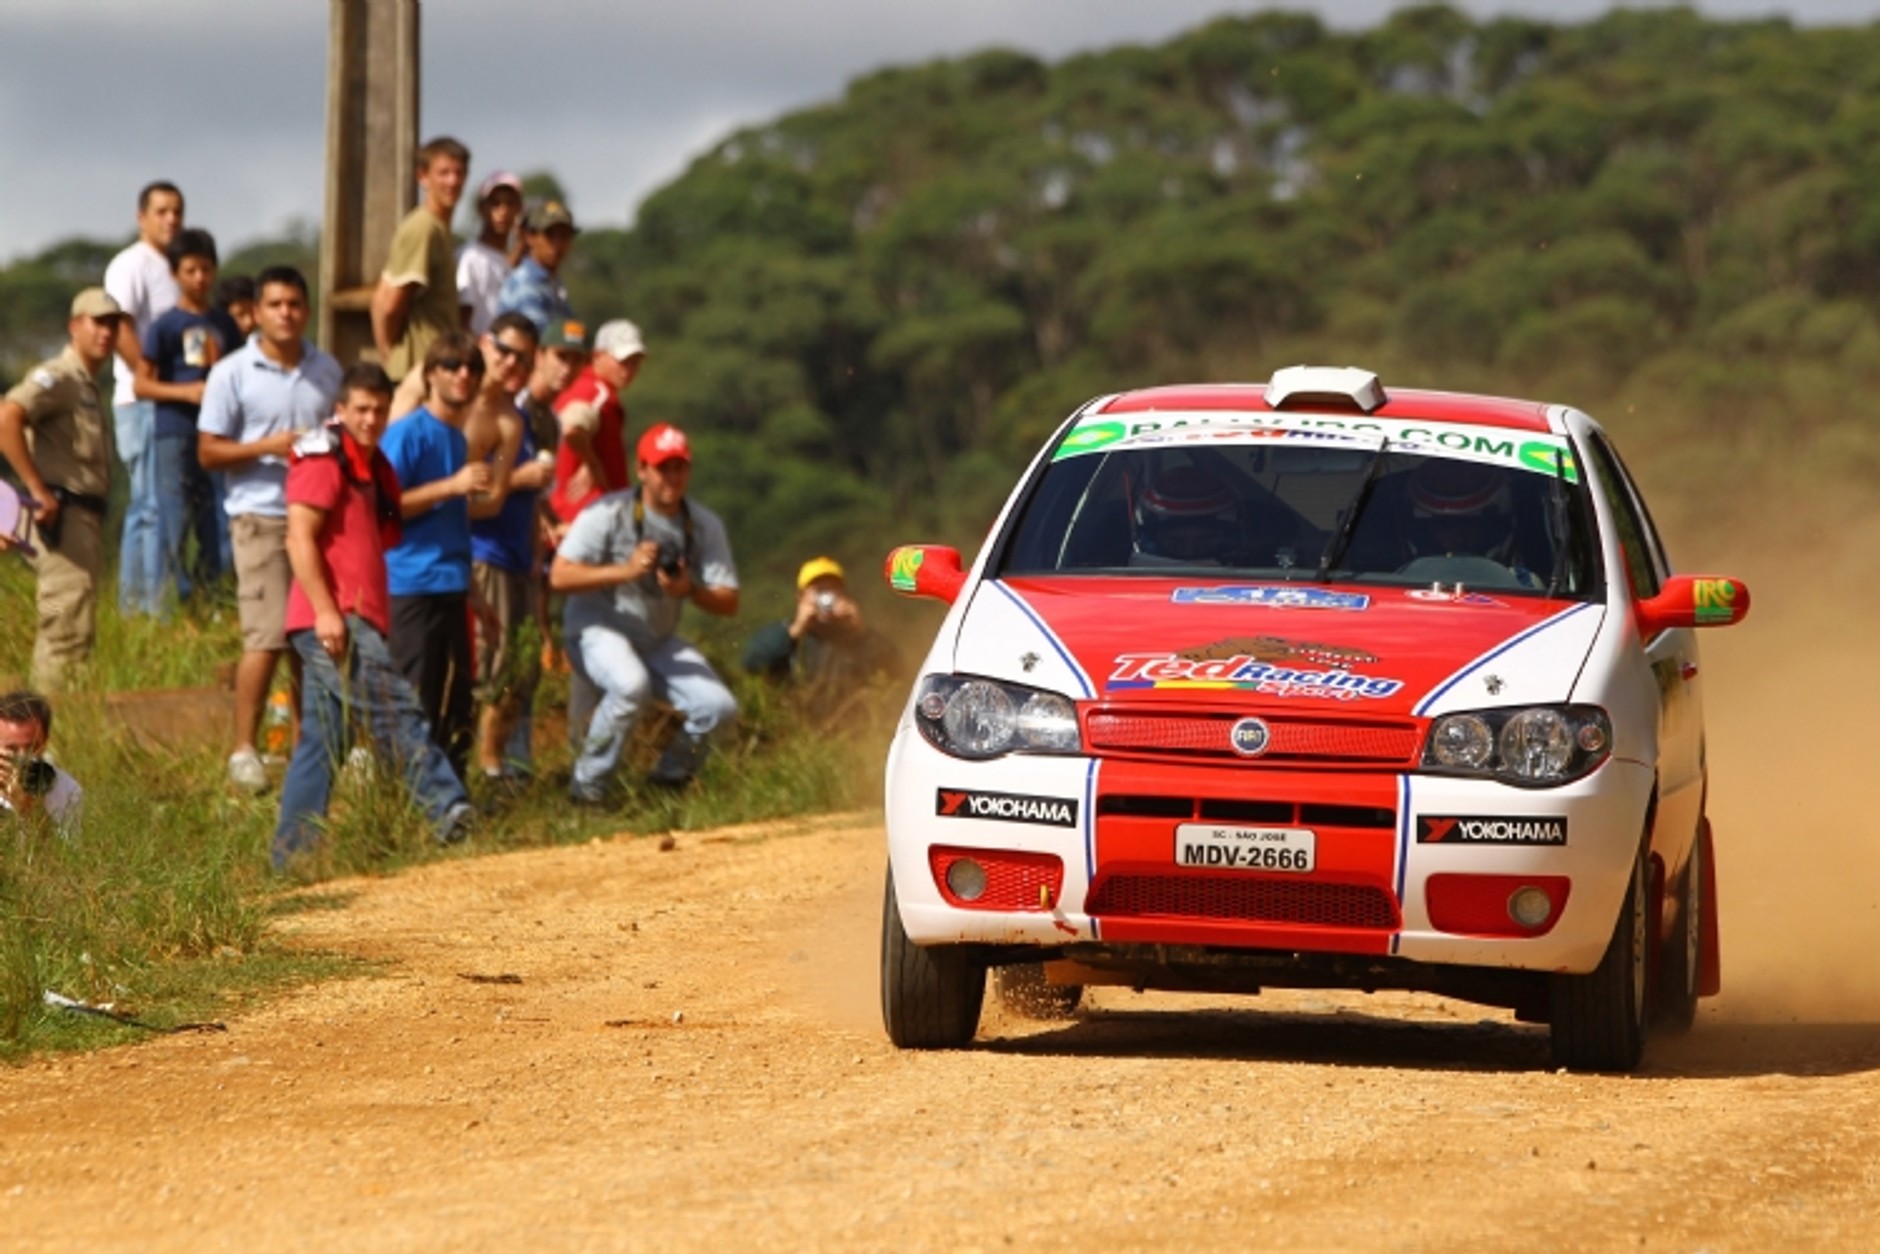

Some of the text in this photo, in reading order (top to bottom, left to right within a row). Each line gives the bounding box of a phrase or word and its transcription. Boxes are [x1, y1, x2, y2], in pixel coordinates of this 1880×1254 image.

[968, 795, 1072, 822] YOKOHAMA
[1458, 821, 1562, 841] YOKOHAMA
[1184, 844, 1308, 870] MDV-2666
